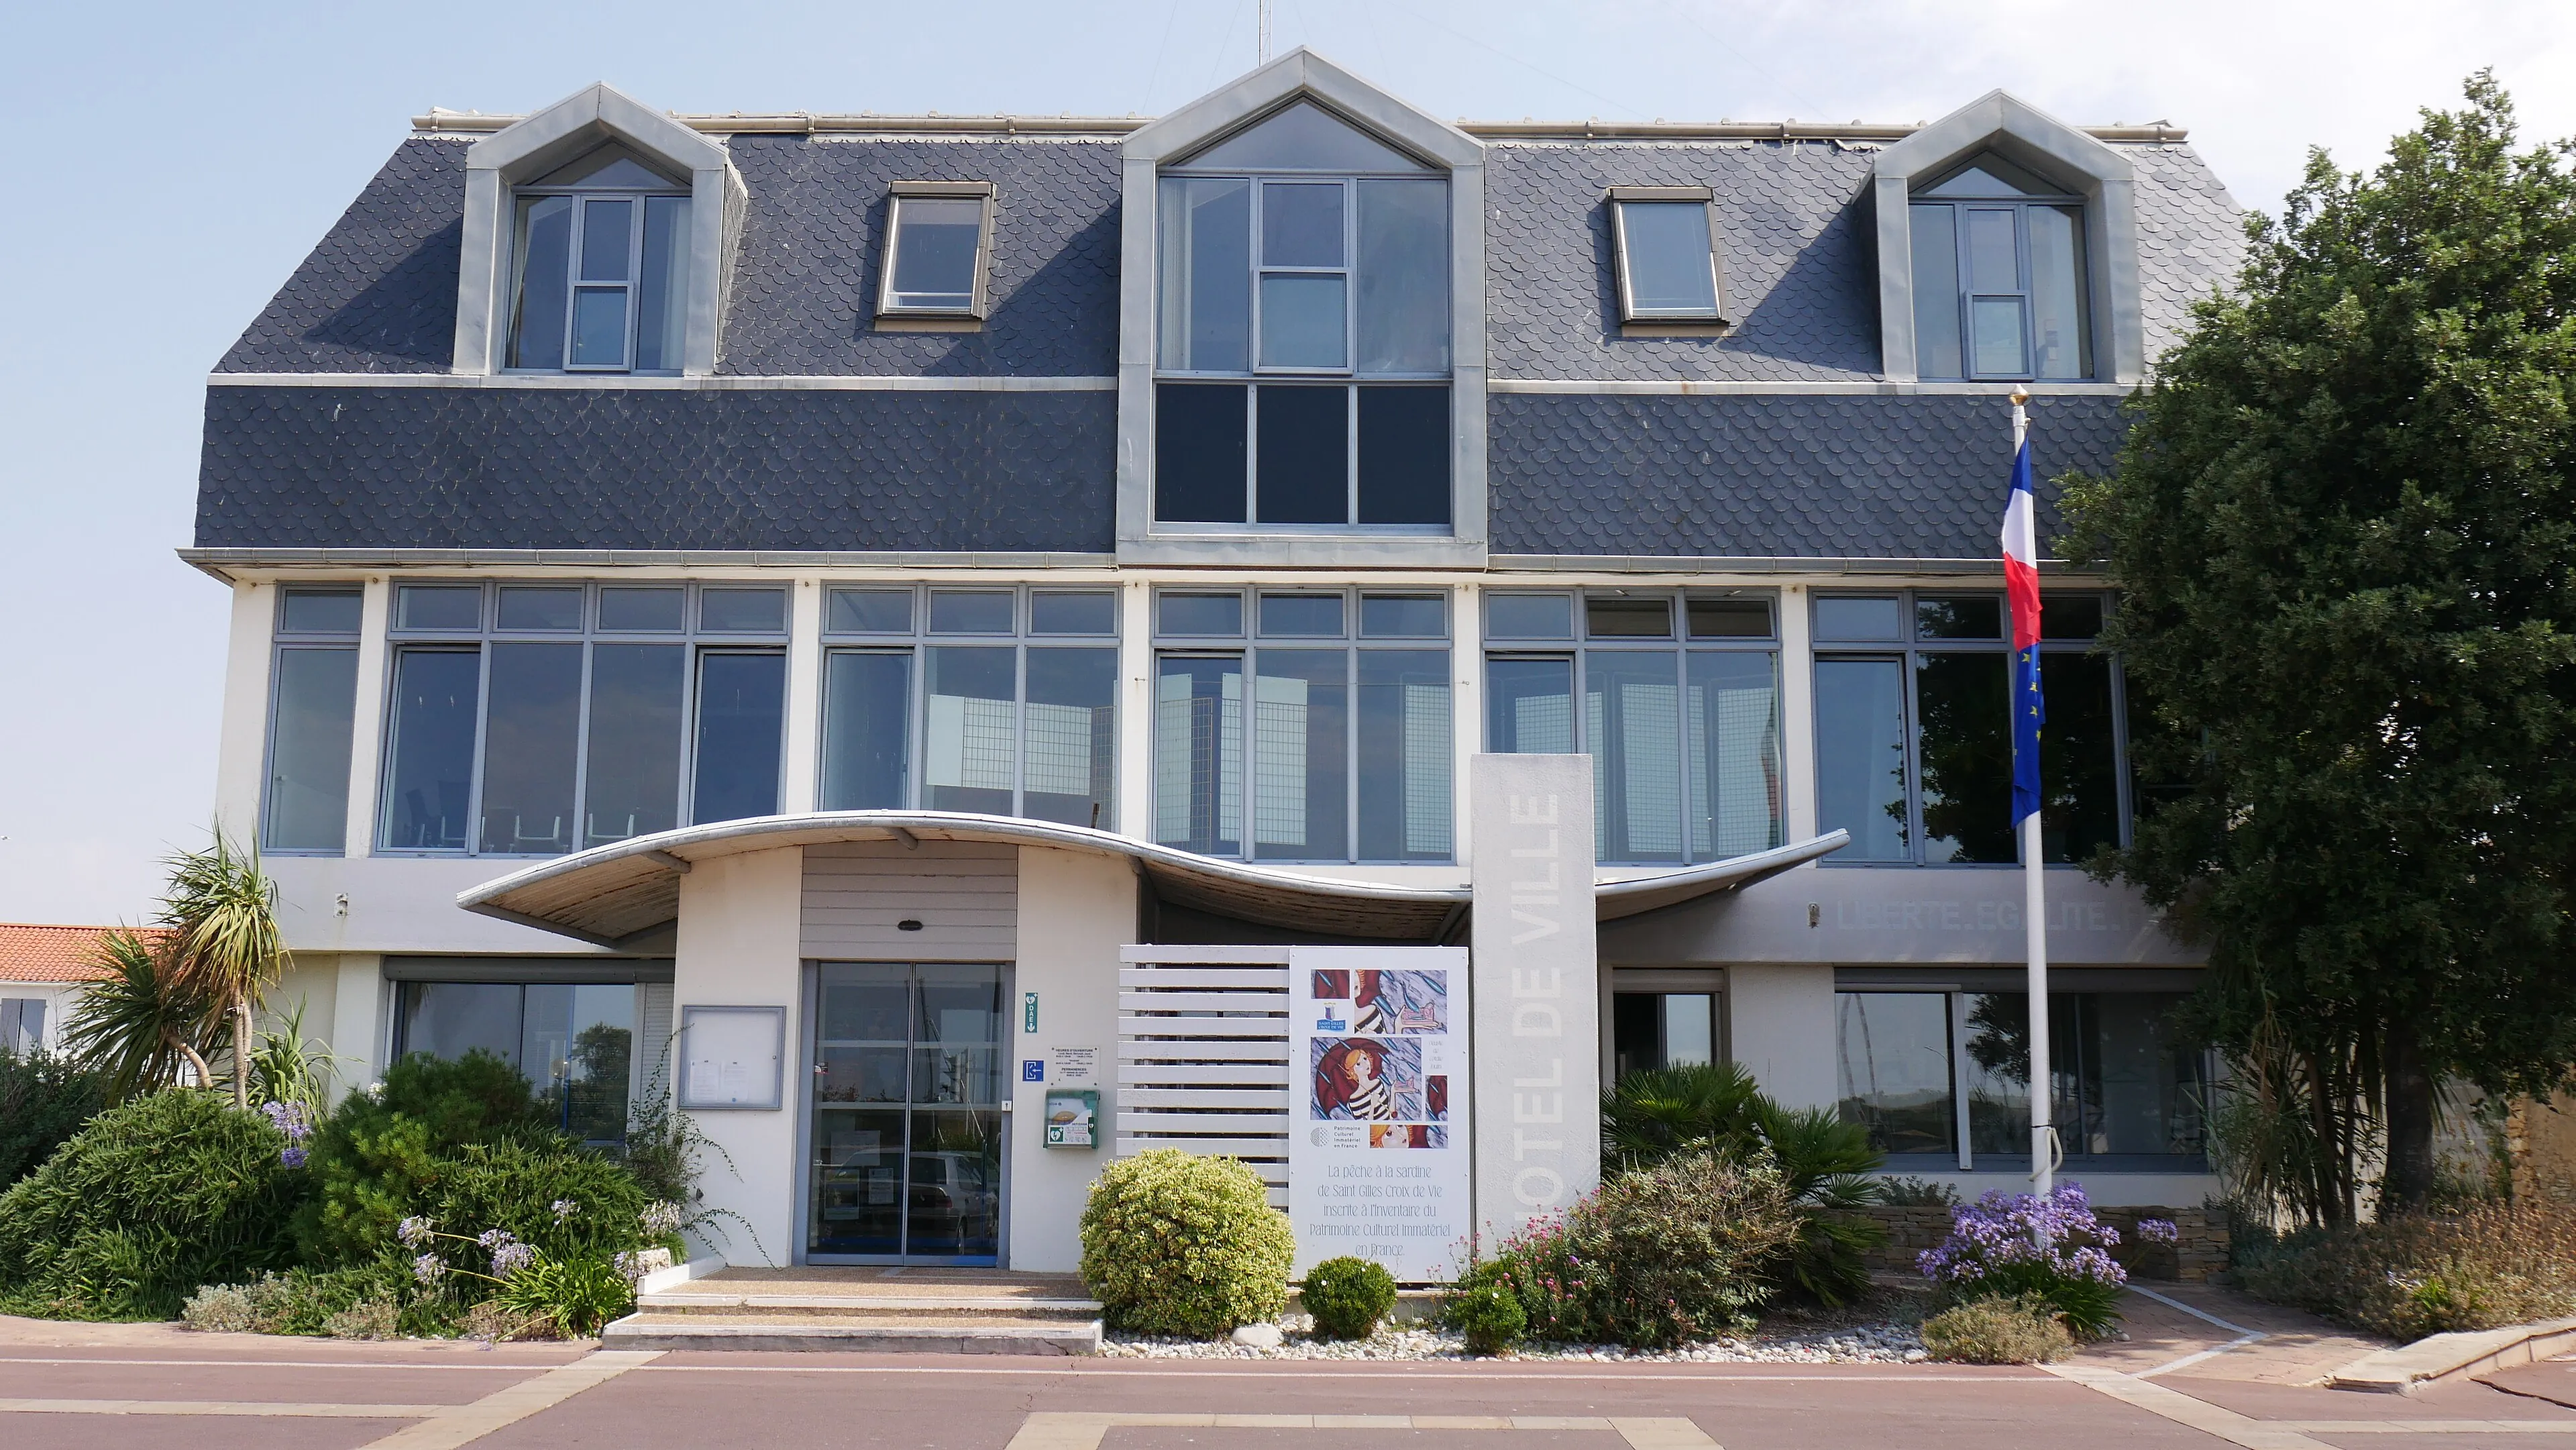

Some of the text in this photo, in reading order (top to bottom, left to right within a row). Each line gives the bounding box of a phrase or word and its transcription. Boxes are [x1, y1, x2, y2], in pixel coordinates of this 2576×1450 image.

[1510, 794, 1558, 944] VILLE
[1512, 967, 1561, 1038] DE
[1328, 1165, 1432, 1179] La pêche à la sardine
[1318, 1184, 1442, 1197] de Saint Gilles Croix de Vie
[1324, 1204, 1358, 1216] inscrite
[1361, 1204, 1367, 1216] à
[1424, 1204, 1436, 1216] du
[1309, 1223, 1450, 1237] Patrimoine Culturel Immatériel
[1355, 1244, 1368, 1256] en
